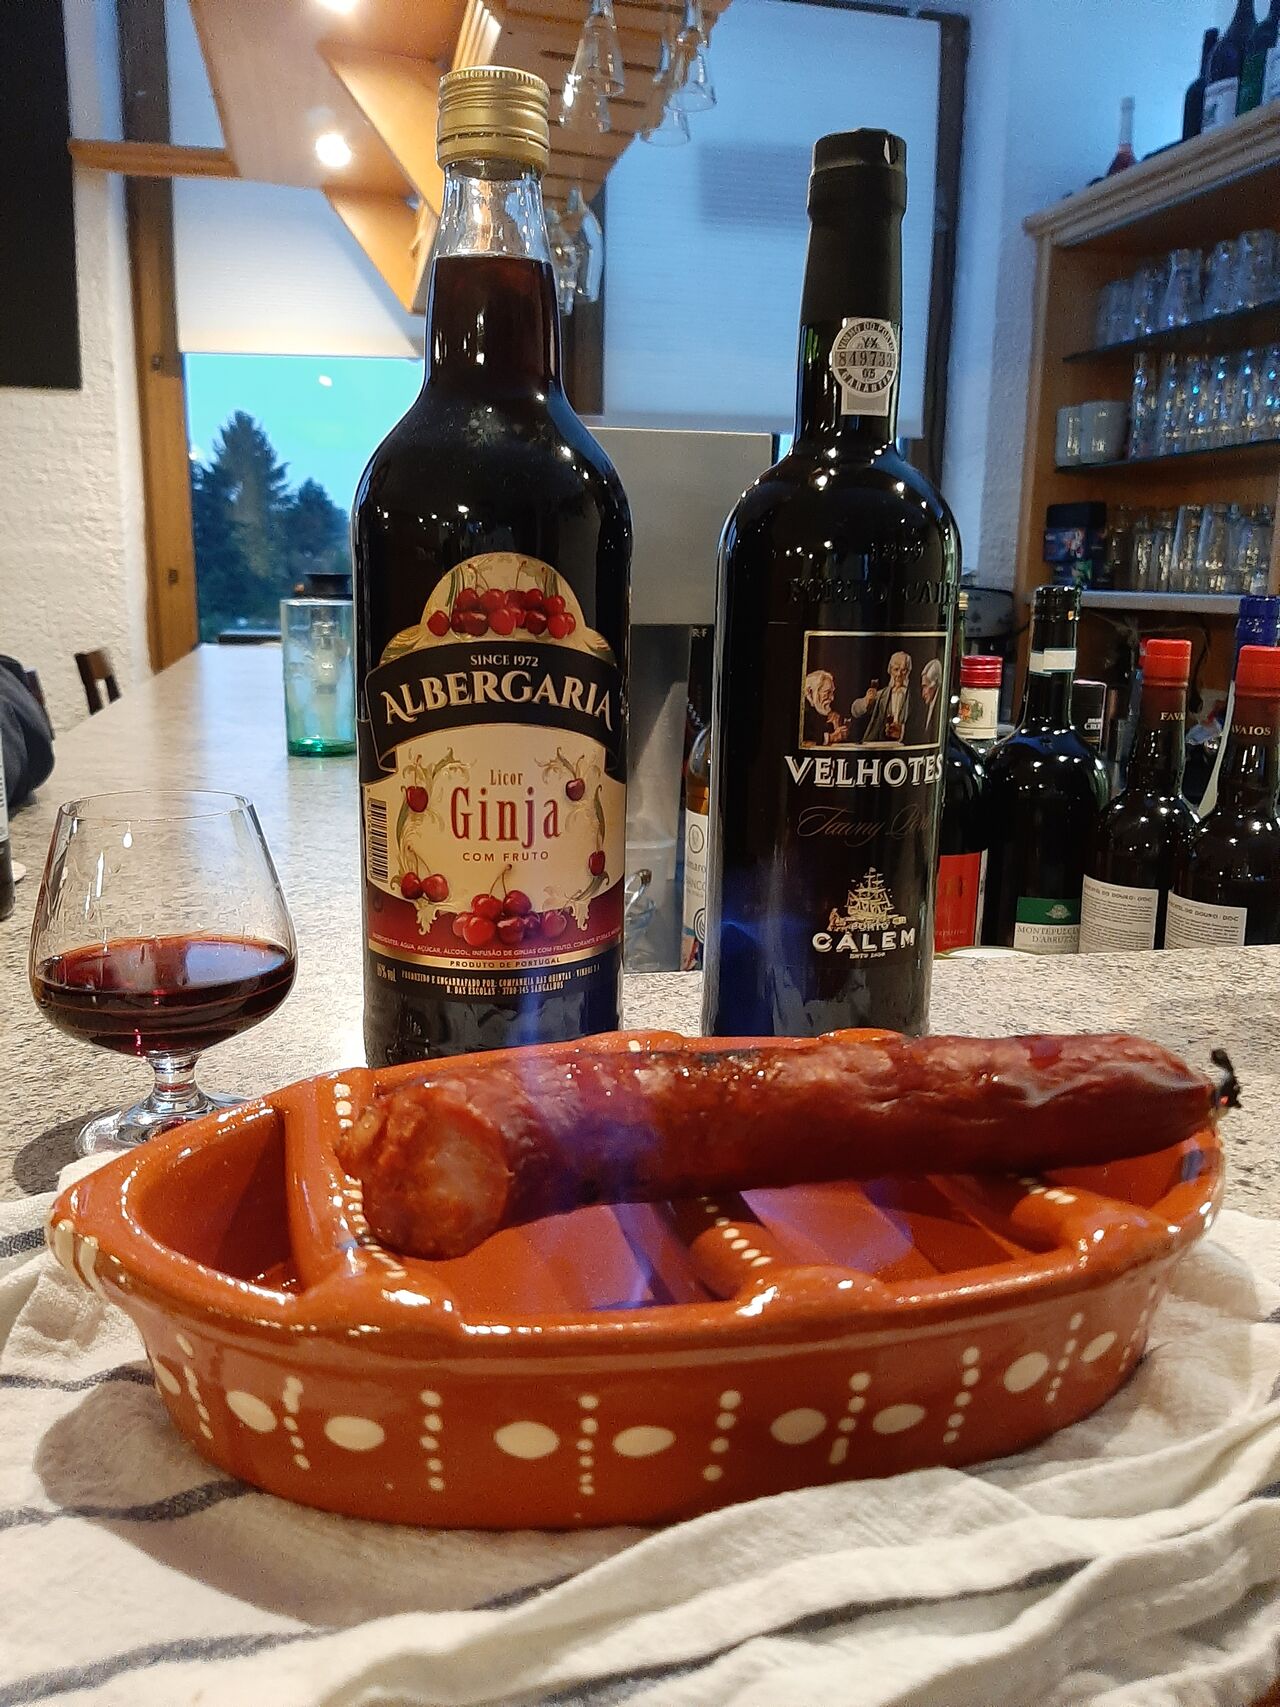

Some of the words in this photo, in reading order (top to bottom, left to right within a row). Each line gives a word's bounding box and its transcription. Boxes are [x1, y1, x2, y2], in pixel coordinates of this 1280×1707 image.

[470, 654, 510, 666] SINCE
[513, 655, 539, 667] 1972
[380, 670, 613, 732] ALBERGARIA
[490, 769, 524, 786] Licor
[784, 753, 943, 788] VELHOTES
[450, 786, 562, 849] Ginja
[462, 852, 495, 862] COM
[503, 851, 549, 862] FRUTO
[449, 960, 495, 968] PRODUTO
[515, 957, 560, 968] PORTUGAL
